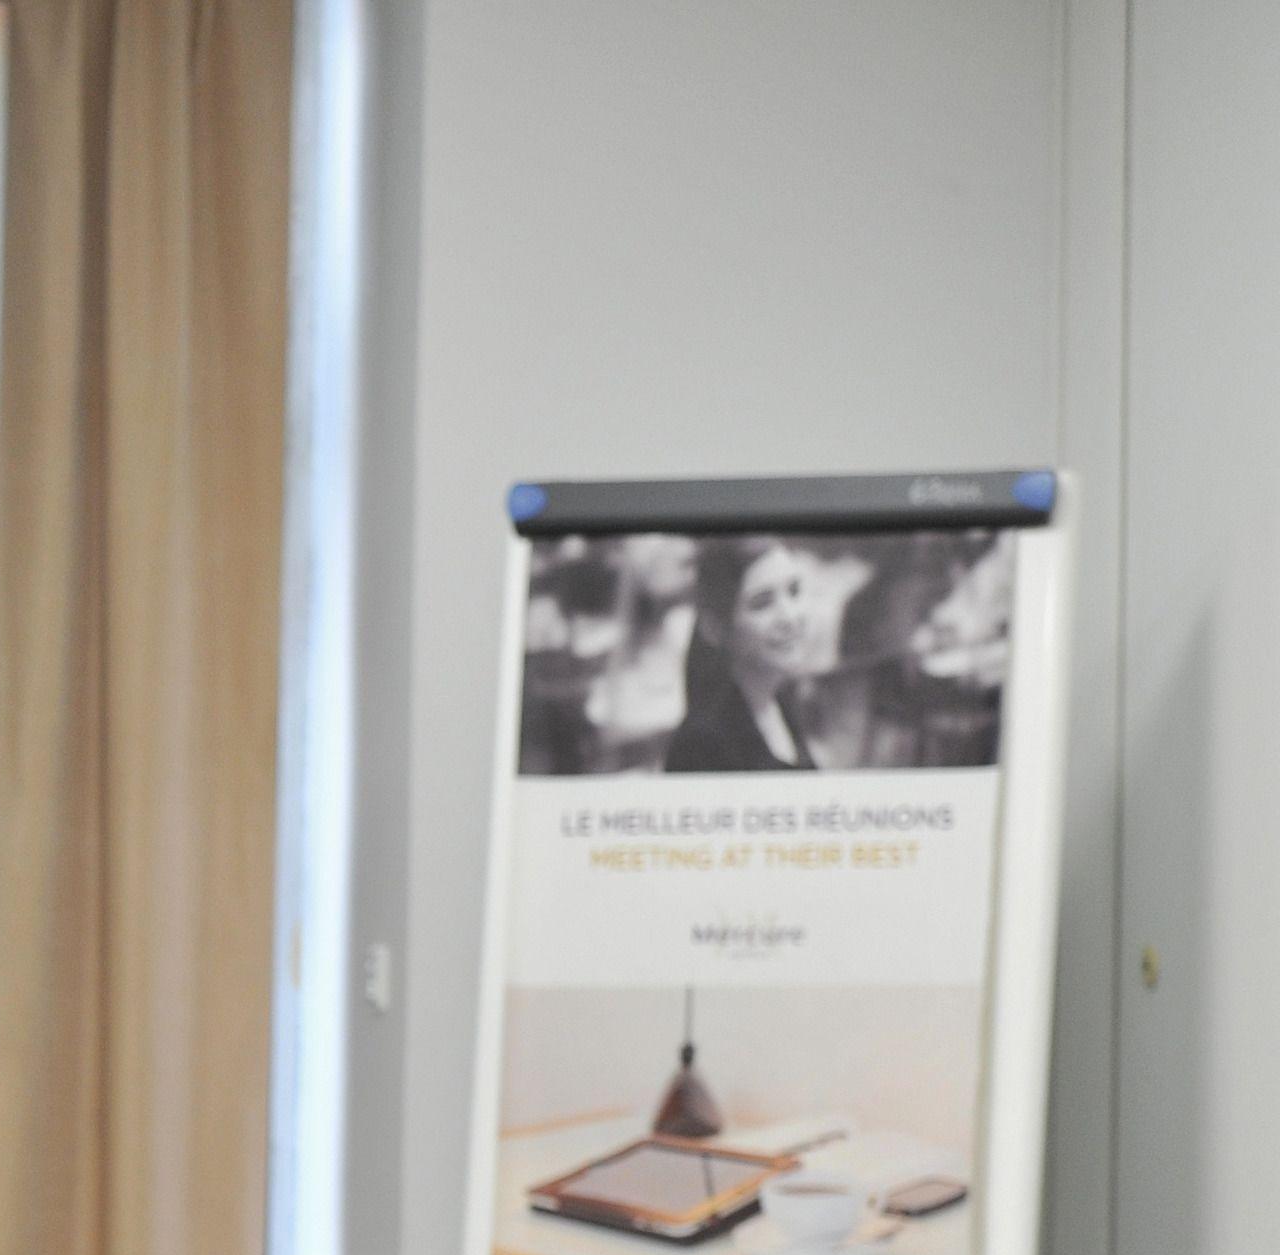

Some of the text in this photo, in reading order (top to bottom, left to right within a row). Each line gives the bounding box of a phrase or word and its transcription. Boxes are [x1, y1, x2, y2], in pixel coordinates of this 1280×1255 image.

[560, 798, 957, 837] LE MEILLEUR DES RÉUNIONS
[589, 839, 921, 871] MEETING AT THEIR BEST
